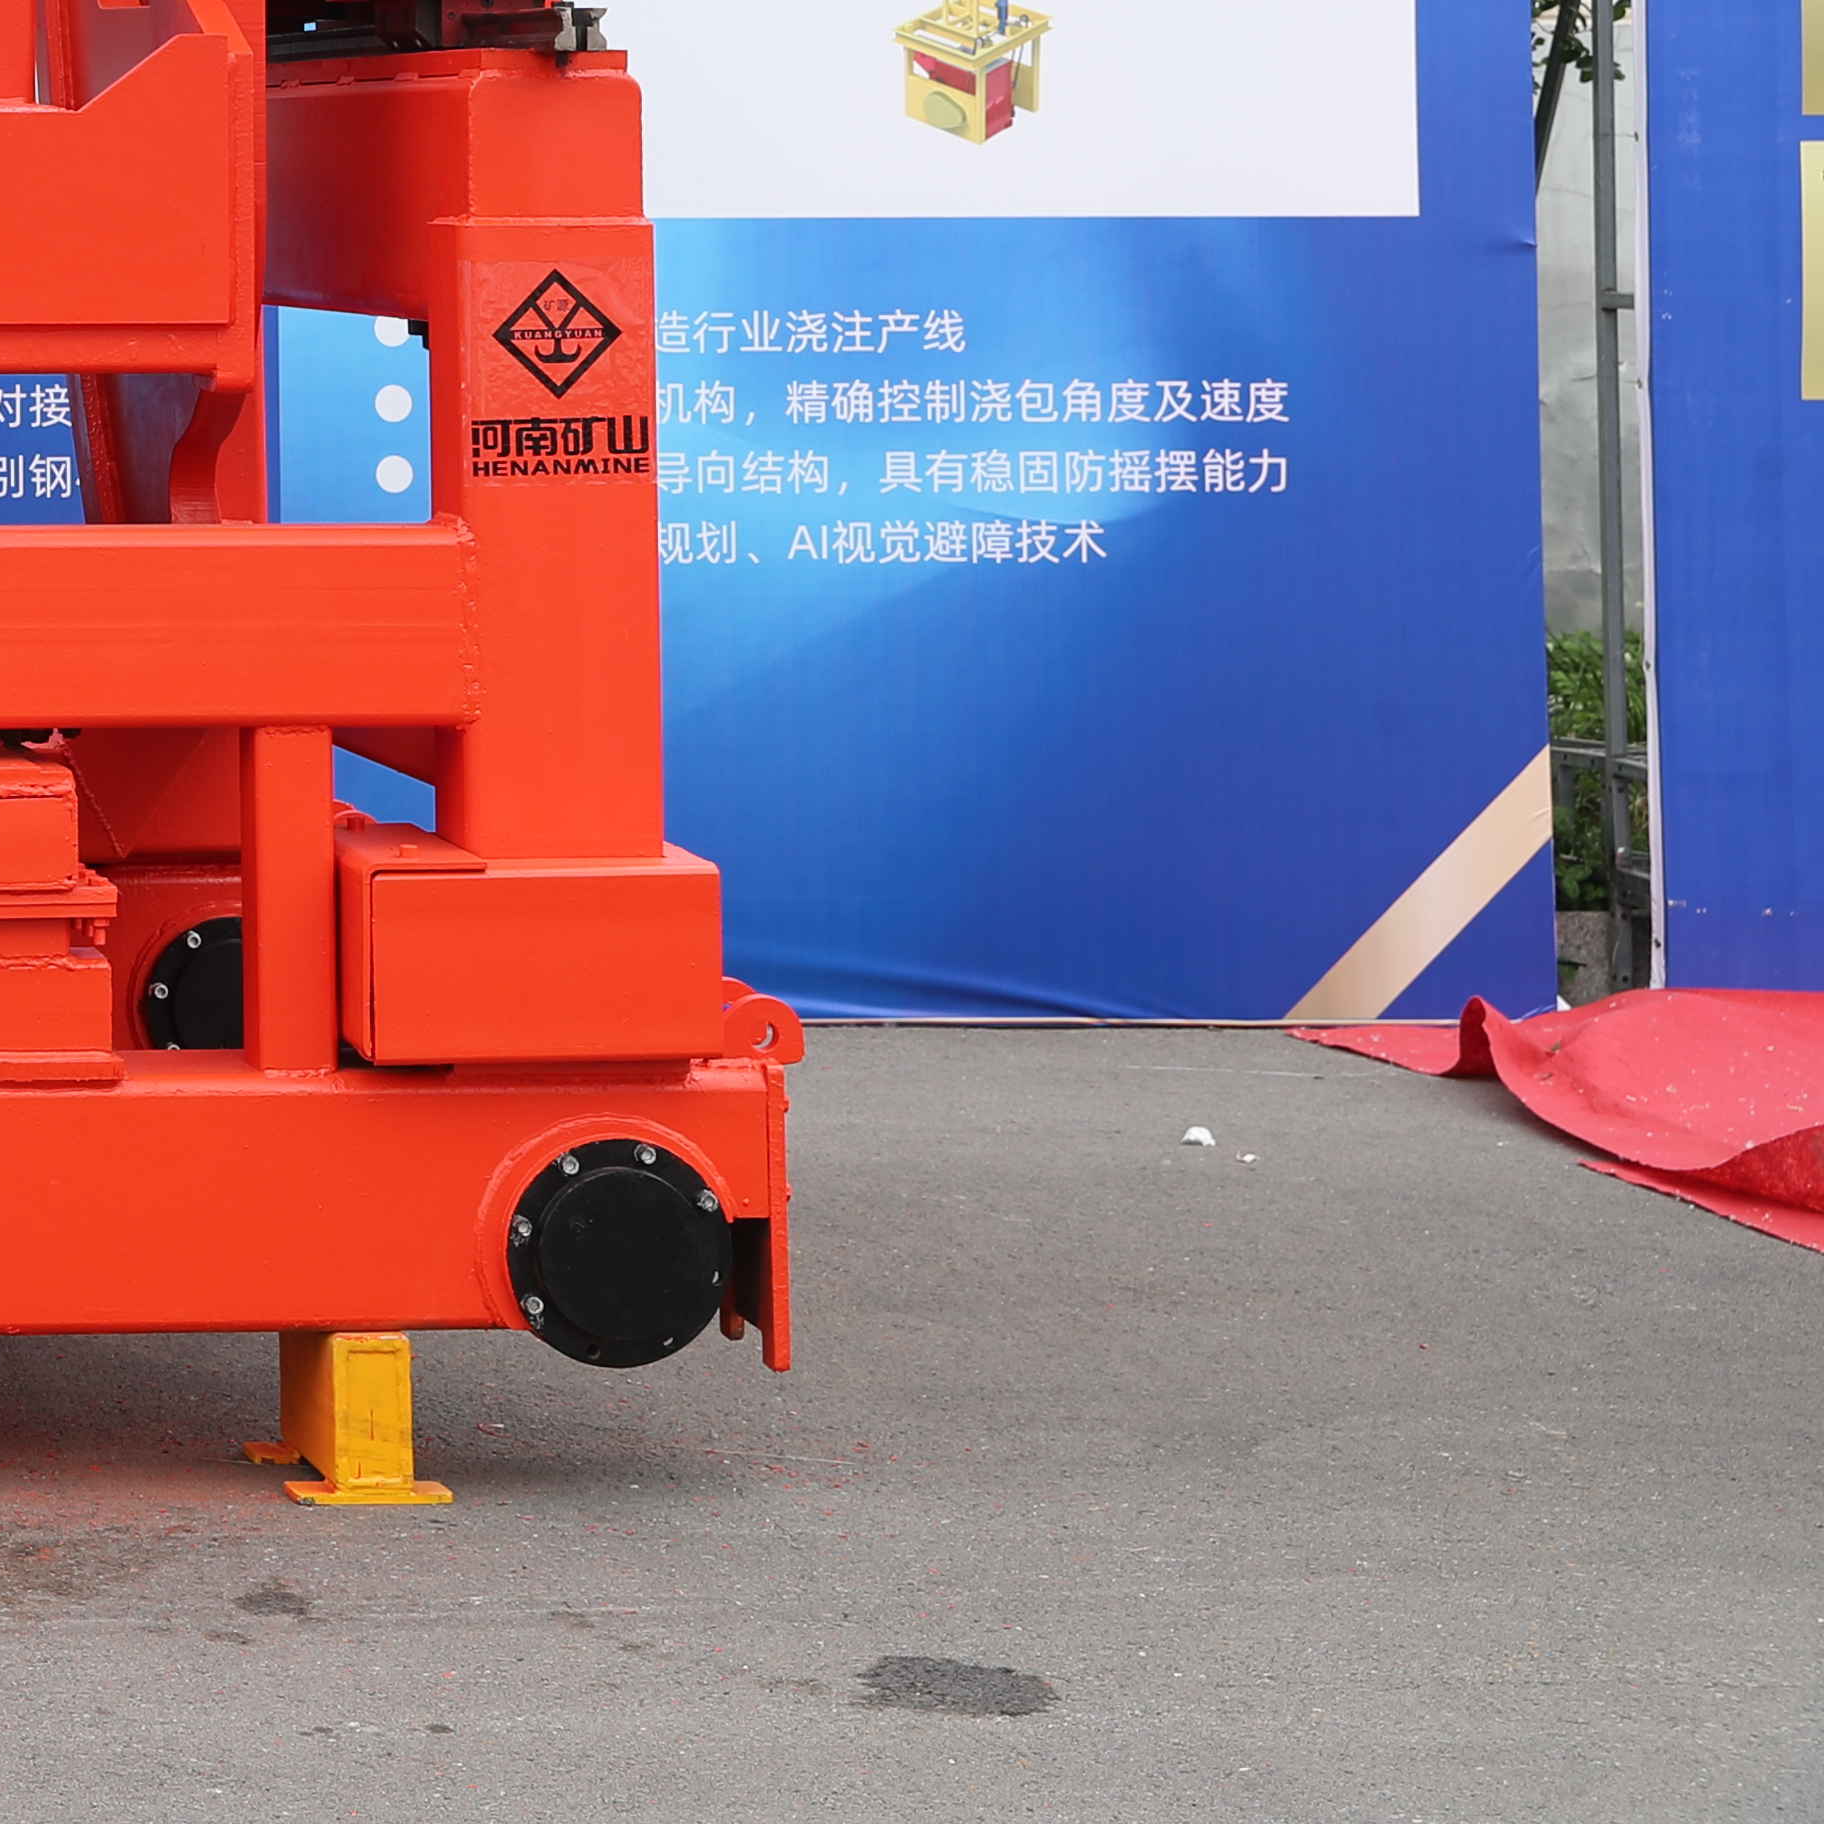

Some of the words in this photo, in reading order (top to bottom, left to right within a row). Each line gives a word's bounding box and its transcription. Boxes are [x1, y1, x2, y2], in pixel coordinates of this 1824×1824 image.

[513, 329, 603, 339] KUANGYUAN
[655, 309, 967, 354] 造行业浇注产线
[471, 415, 650, 458] 河南矿山
[472, 457, 650, 477] HENANMINE
